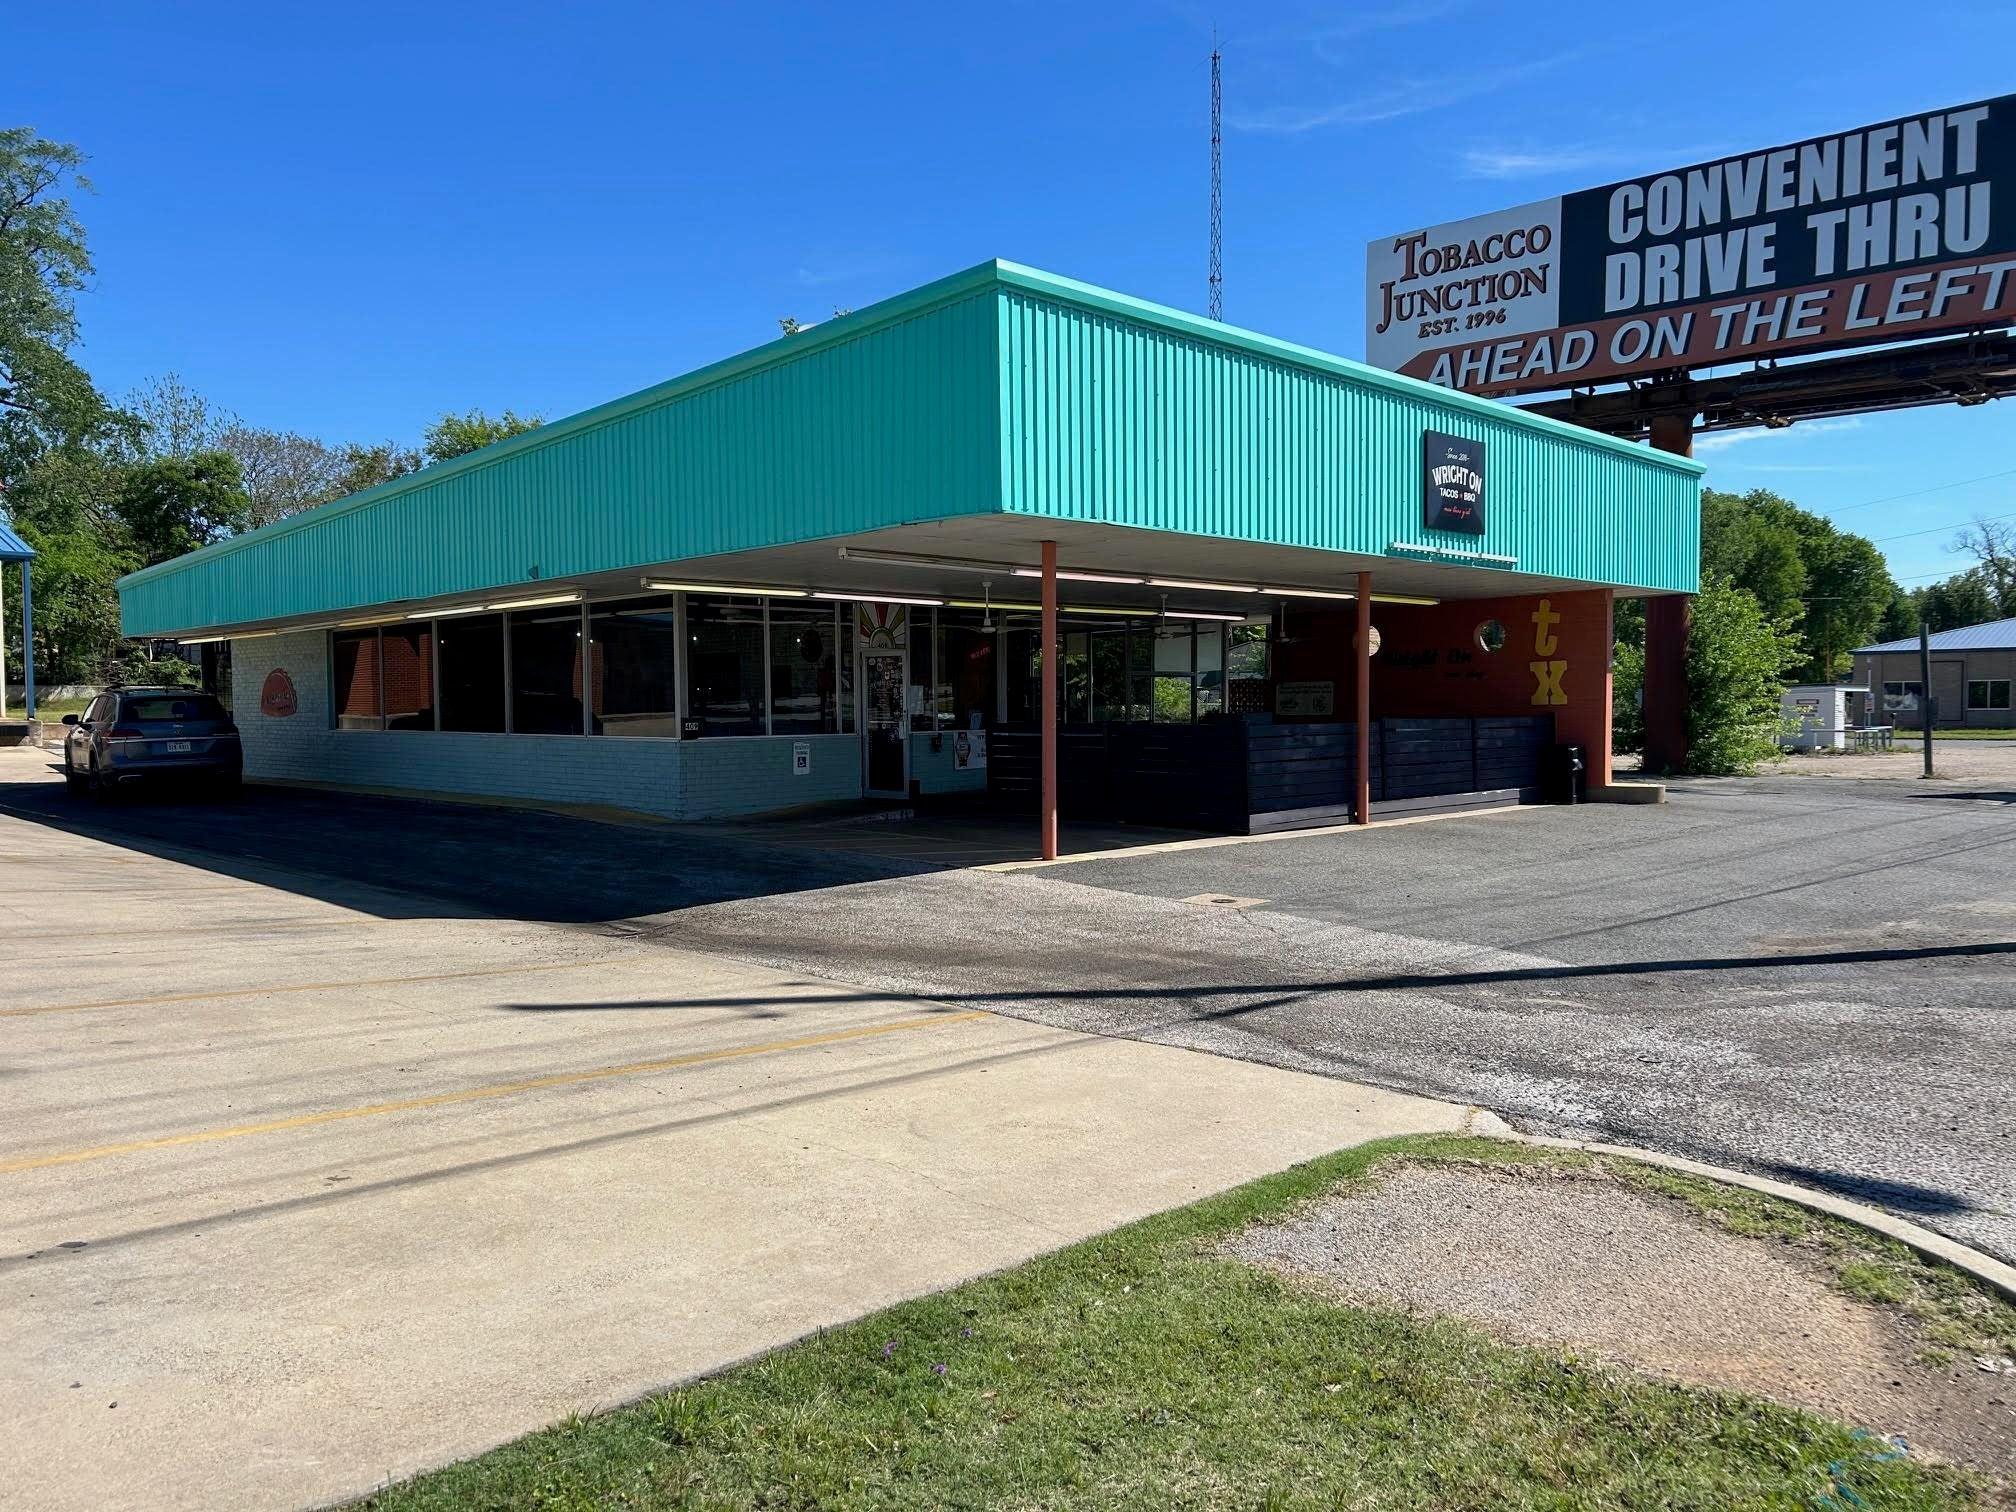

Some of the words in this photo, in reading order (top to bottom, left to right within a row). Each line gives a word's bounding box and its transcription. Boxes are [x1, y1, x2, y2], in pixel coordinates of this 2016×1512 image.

[1608, 105, 1990, 245] CONVENIENT
[1393, 224, 1551, 283] TOBACCO
[1604, 222, 1777, 313] DRIVE
[1807, 181, 1991, 276] THRU
[1376, 263, 1550, 334] JUNCTION
[1417, 317, 1459, 338] EST.
[1465, 308, 1507, 330] 1996
[1427, 329, 1598, 391] AHEAD
[1611, 311, 1696, 365] ON
[1711, 289, 1837, 348] THE
[1844, 260, 2016, 331] LEFT
[1432, 465, 1469, 486] WRIGHT
[1469, 472, 1482, 494] ON
[1440, 487, 1459, 499] TACOS
[1463, 491, 1476, 503] BBQ
